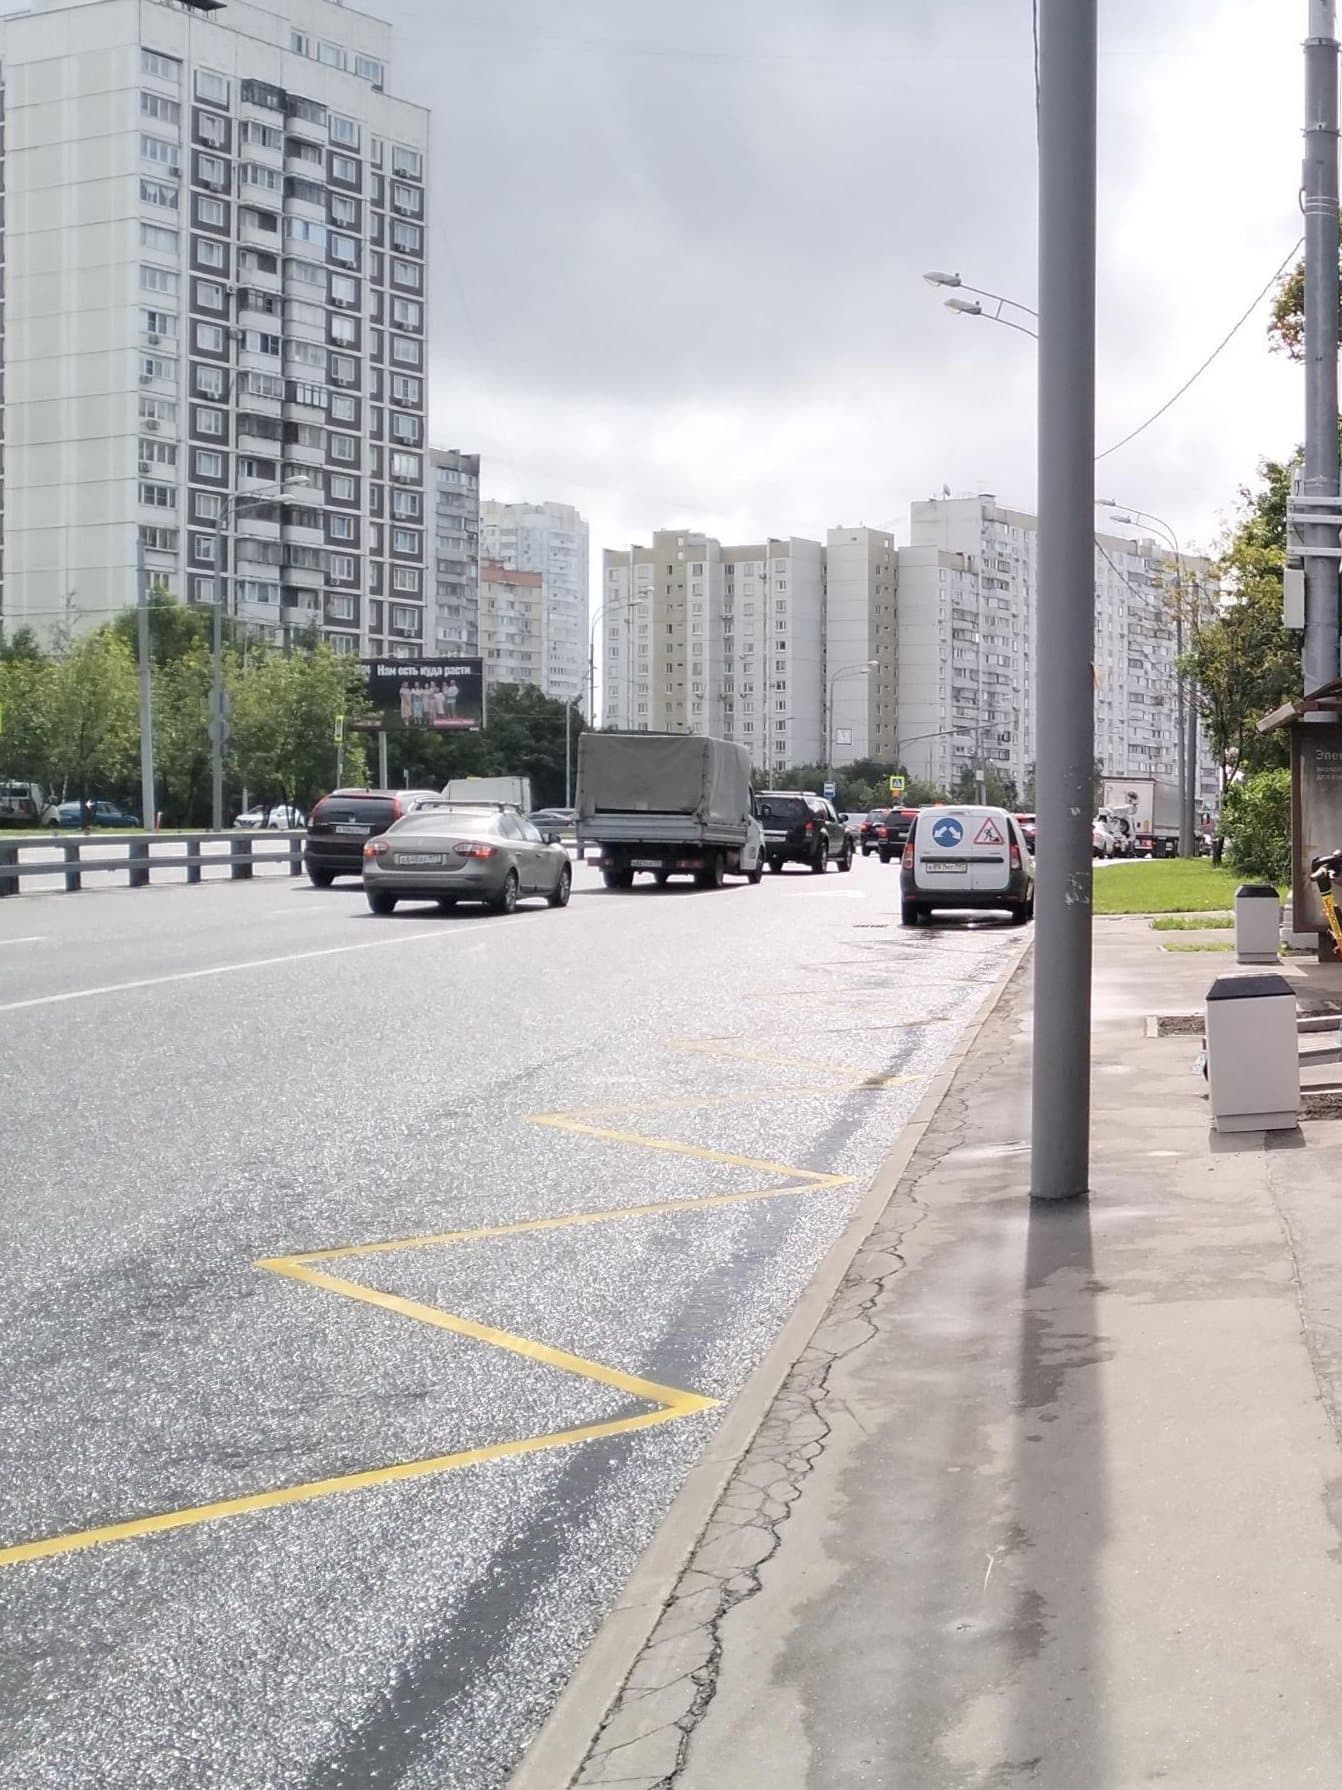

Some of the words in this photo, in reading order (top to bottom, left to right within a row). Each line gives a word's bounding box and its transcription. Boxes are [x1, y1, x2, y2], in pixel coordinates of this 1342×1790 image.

[376, 664, 397, 677] Нам
[398, 666, 419, 676] есть
[420, 666, 443, 678] куда
[444, 666, 471, 678] расти
